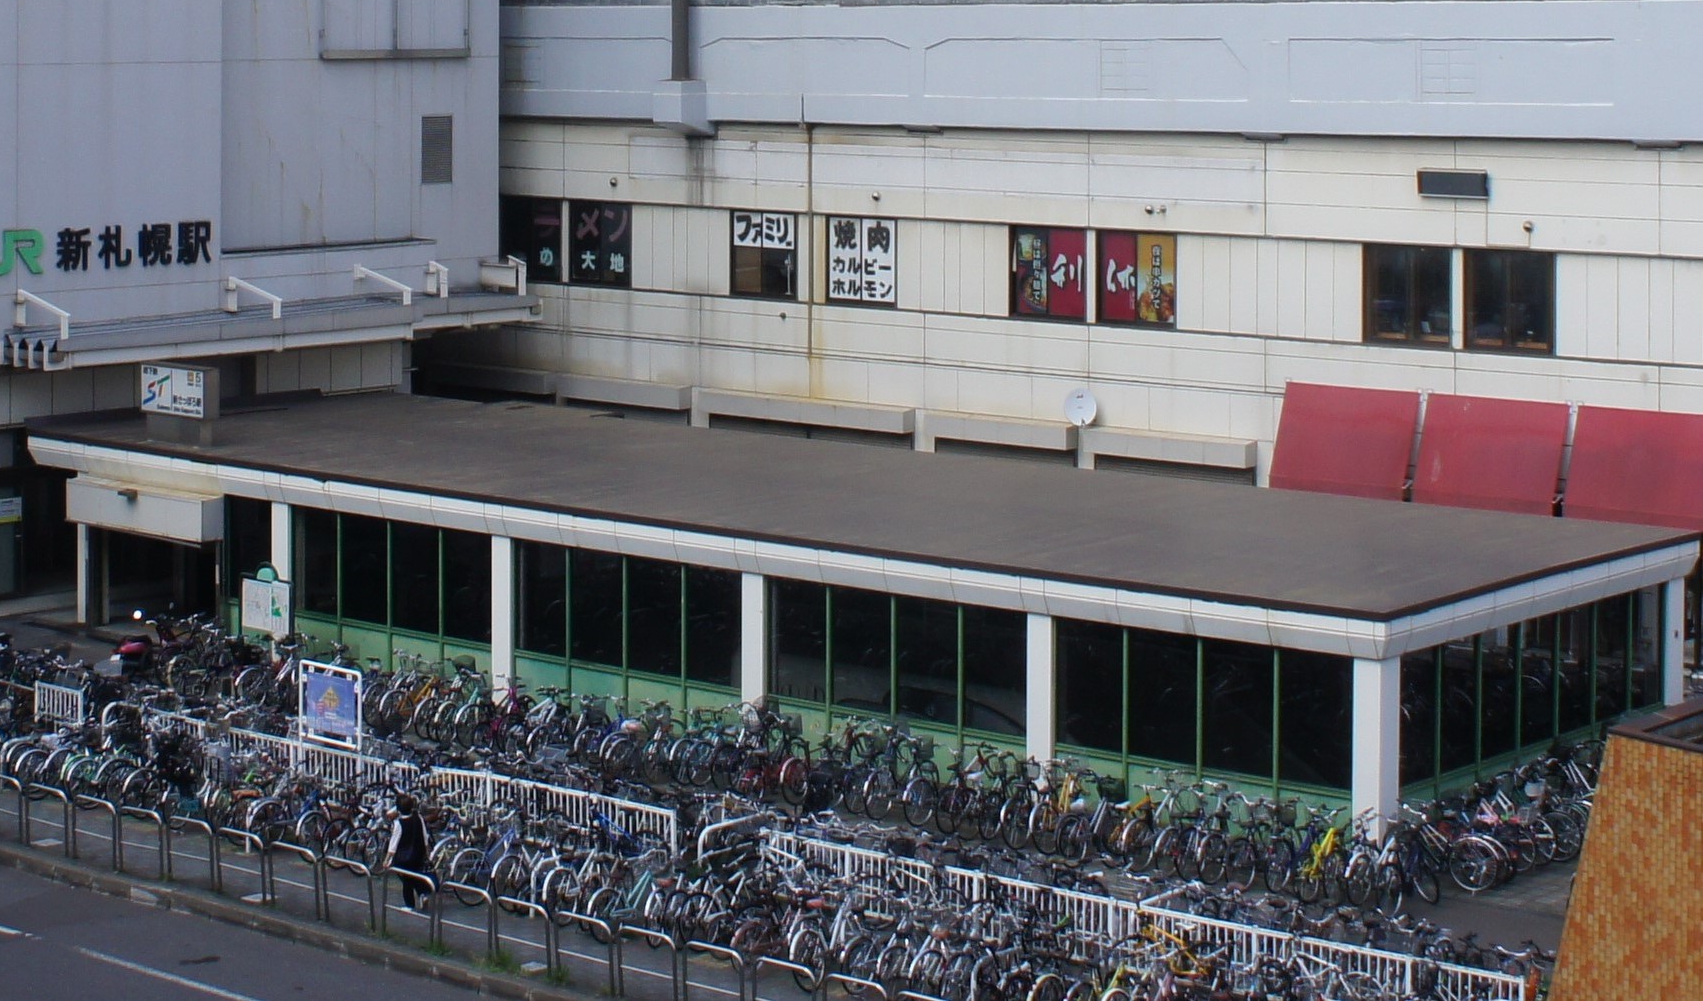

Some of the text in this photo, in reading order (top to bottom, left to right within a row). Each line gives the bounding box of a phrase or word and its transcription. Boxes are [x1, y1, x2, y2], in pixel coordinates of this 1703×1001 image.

[55, 220, 213, 272] 新札幌駅
[833, 219, 891, 254] 焼肉
[832, 256, 892, 276] カルビー
[831, 278, 893, 299] ホルモン
